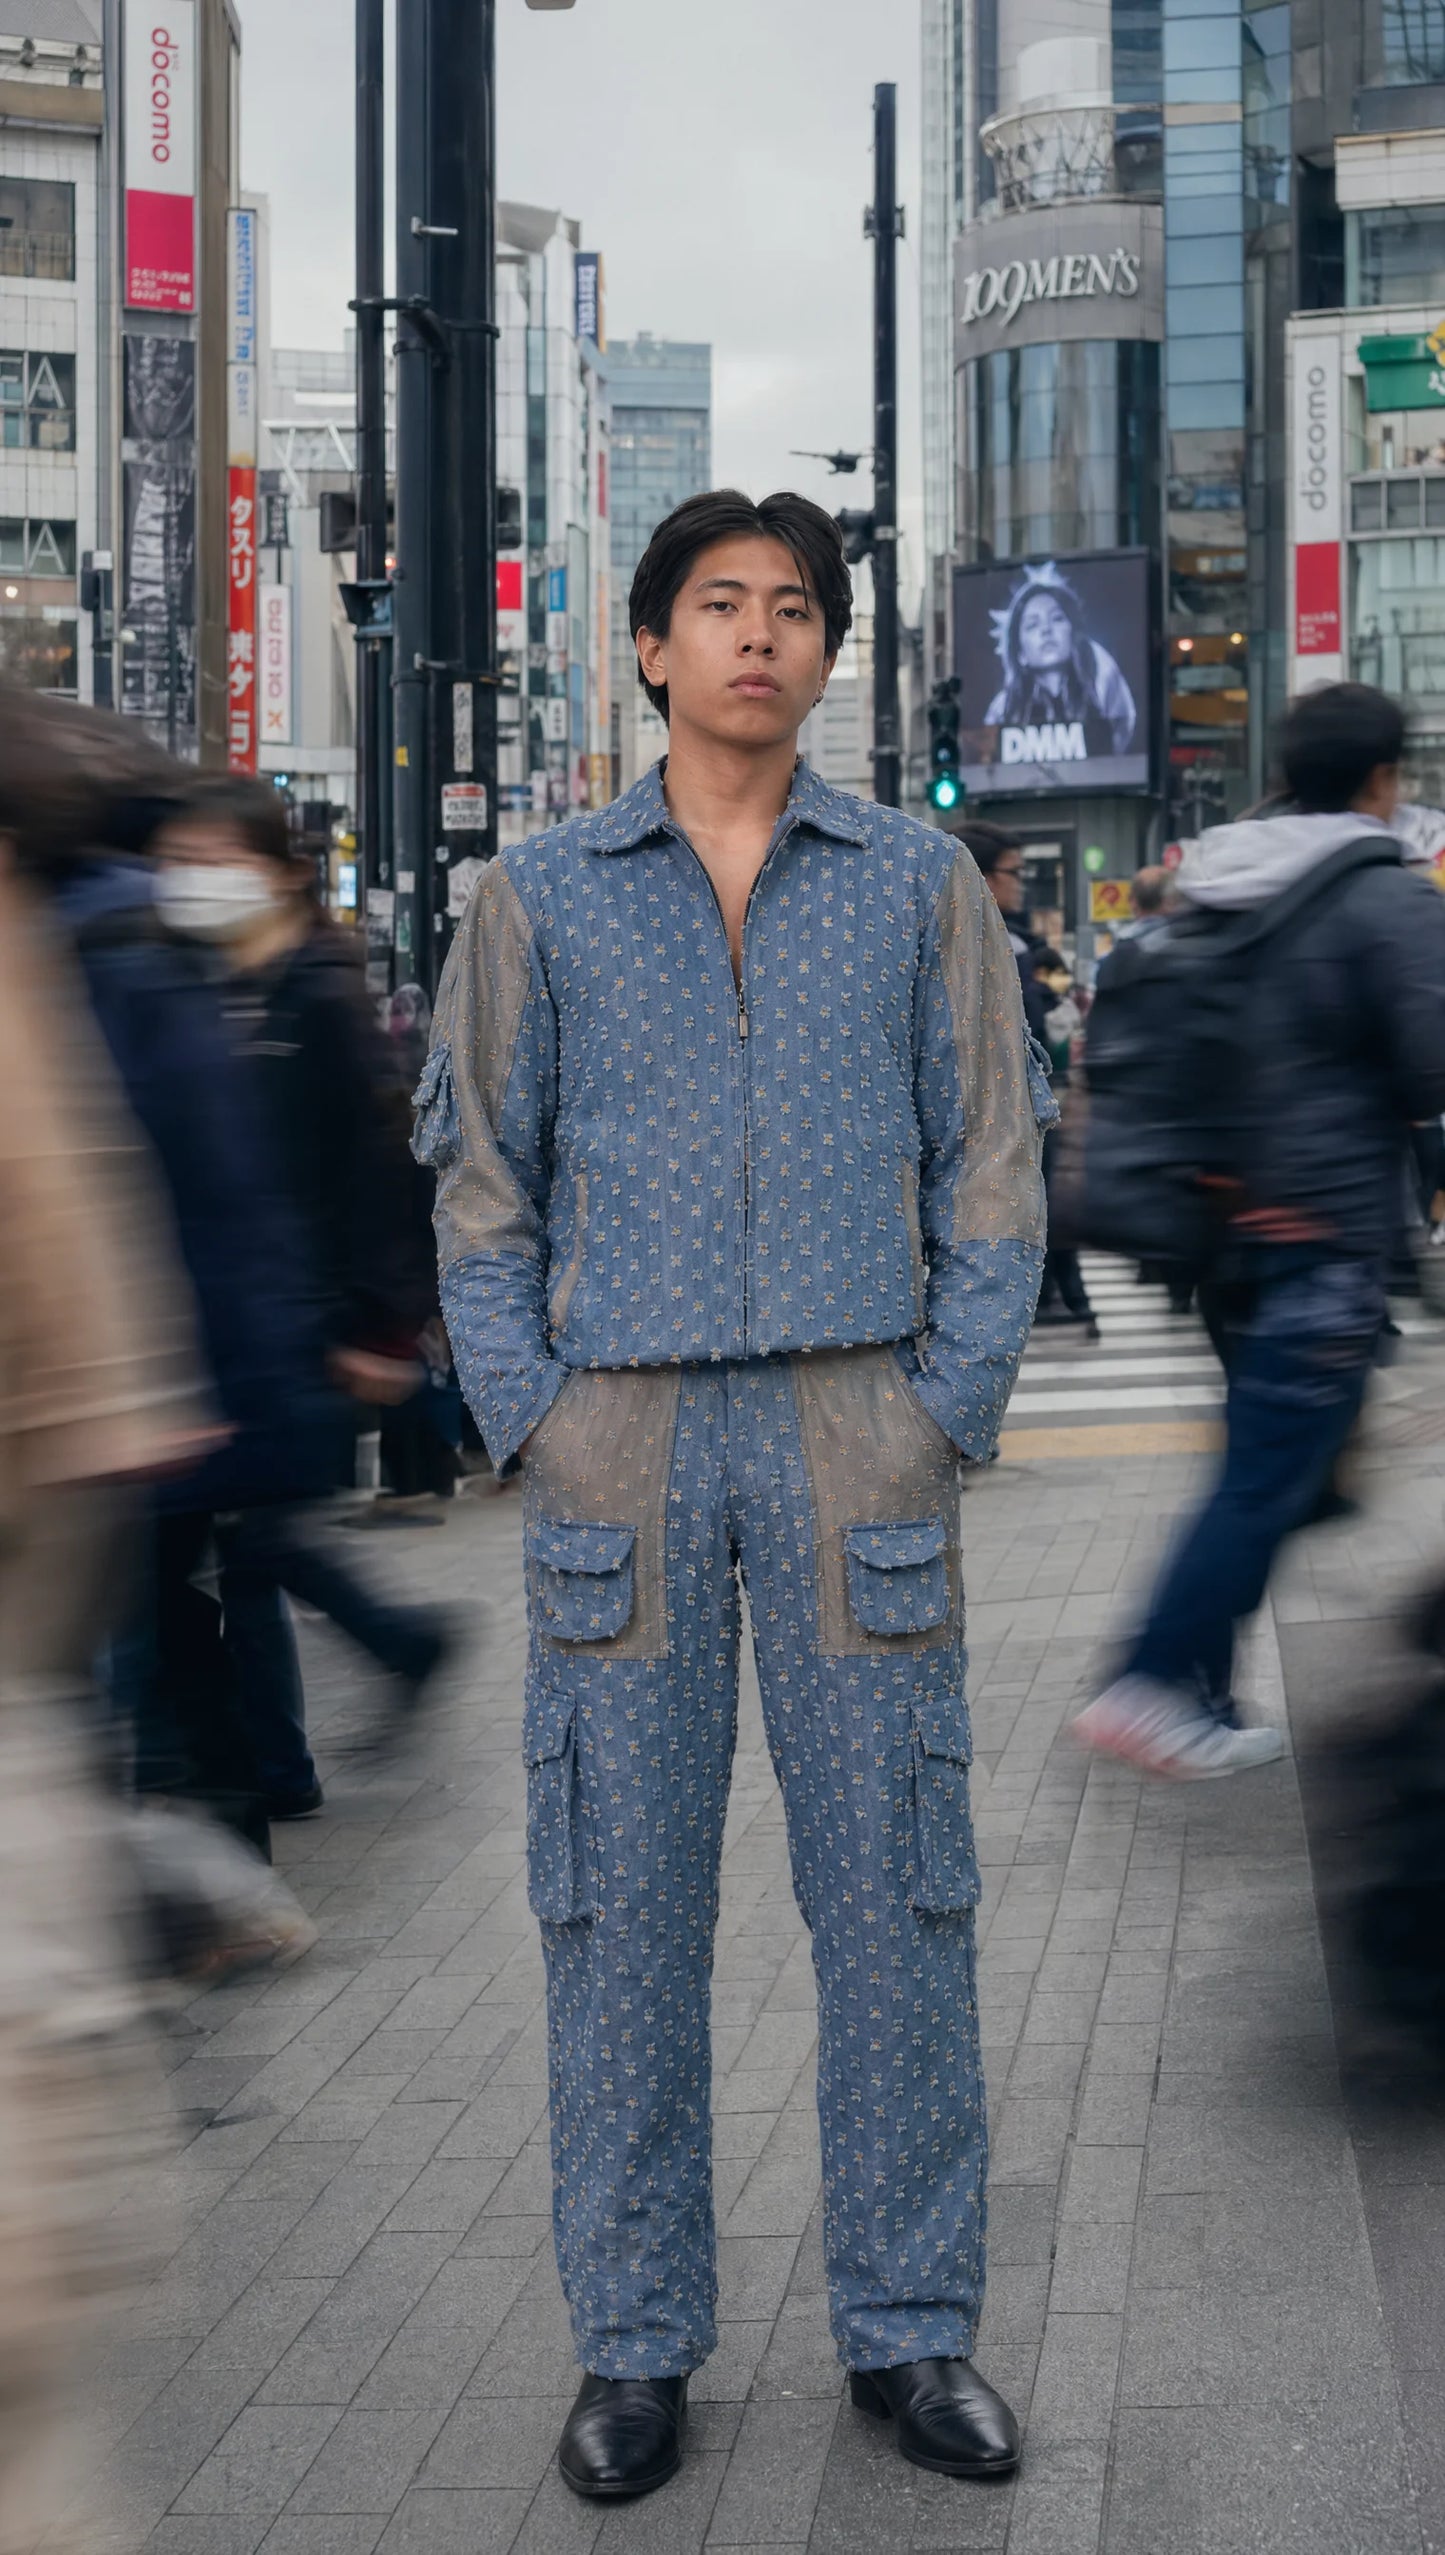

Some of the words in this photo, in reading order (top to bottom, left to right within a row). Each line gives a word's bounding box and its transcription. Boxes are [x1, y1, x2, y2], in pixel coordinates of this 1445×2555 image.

[151, 28, 179, 163] docomo
[1300, 366, 1326, 511] docomo
[1001, 722, 1088, 764] DMM
